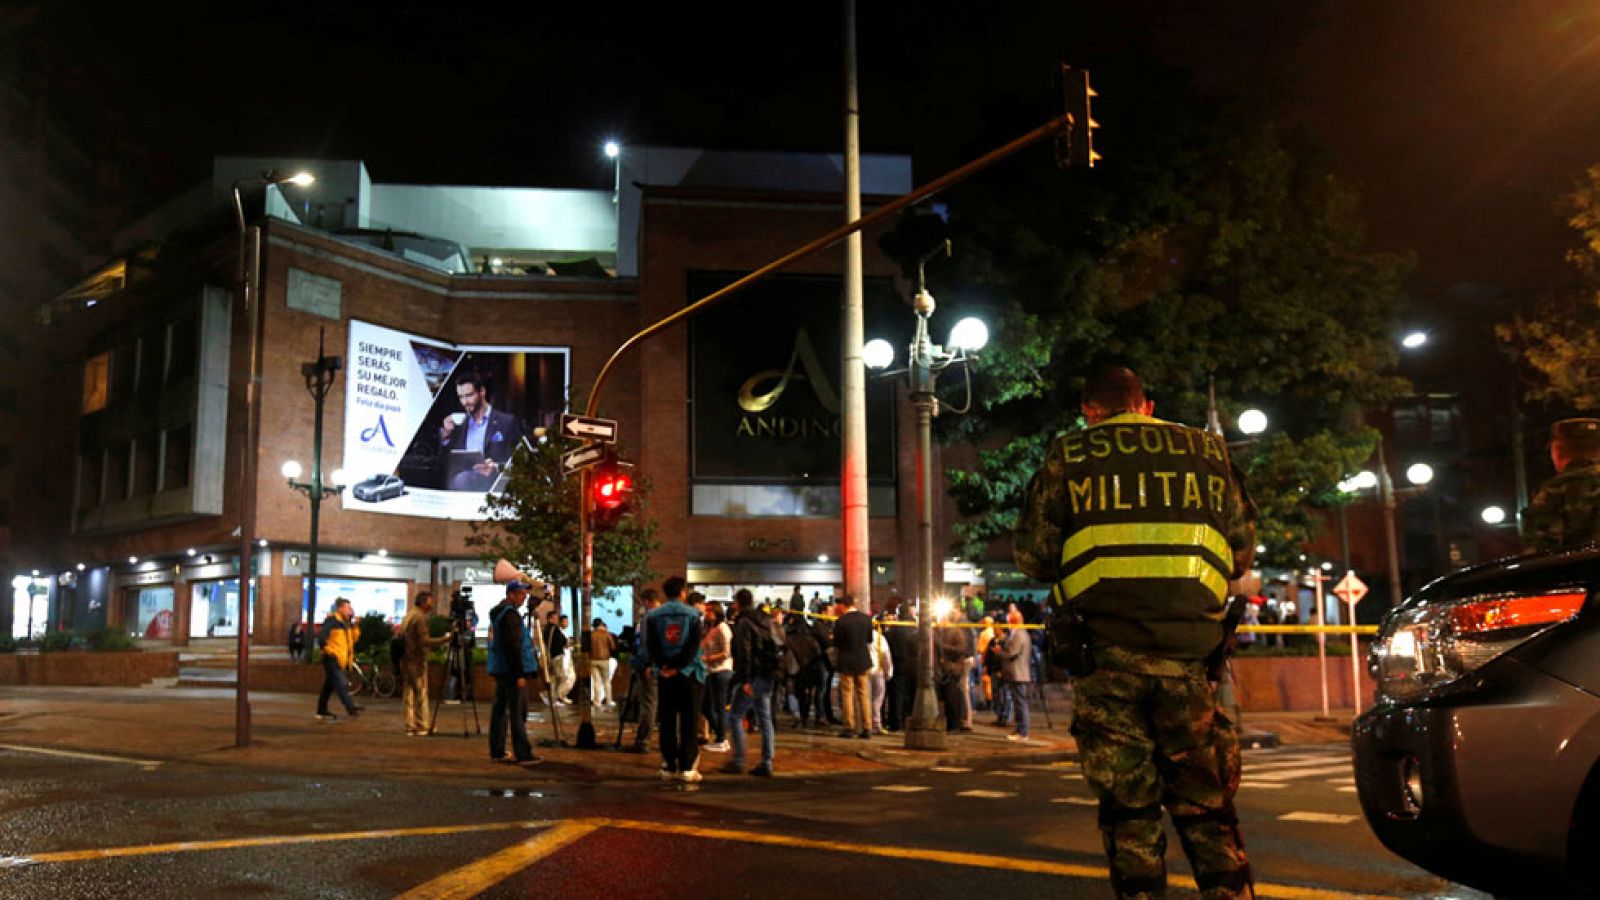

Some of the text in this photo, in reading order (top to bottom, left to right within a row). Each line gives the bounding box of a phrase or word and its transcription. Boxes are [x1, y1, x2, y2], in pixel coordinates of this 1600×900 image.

[358, 341, 403, 361] SIEMPRE
[357, 369, 407, 389] SU MEJOR
[1063, 427, 1225, 463] ESCOLTA
[1068, 471, 1226, 514] MILITAR
